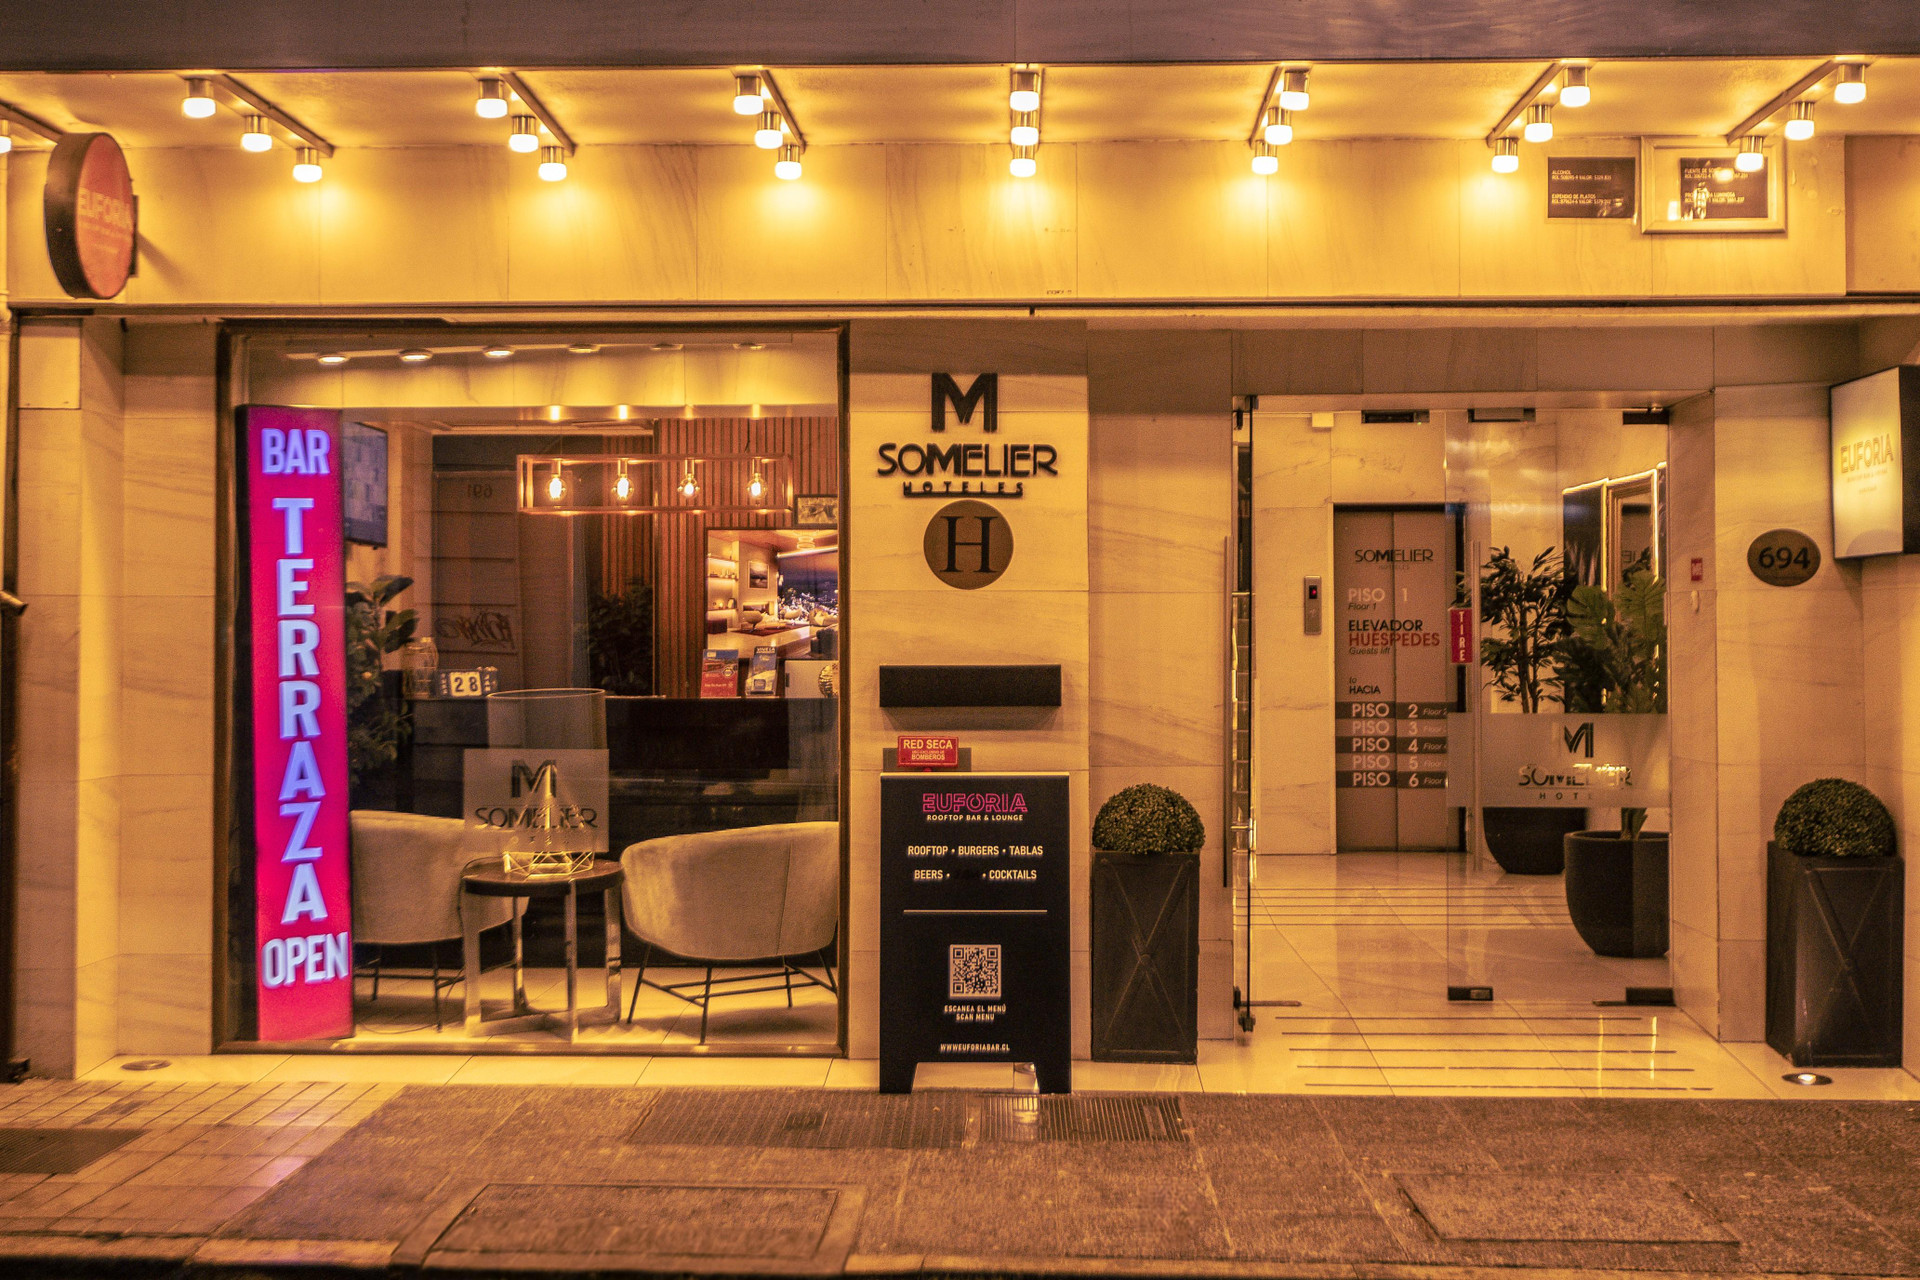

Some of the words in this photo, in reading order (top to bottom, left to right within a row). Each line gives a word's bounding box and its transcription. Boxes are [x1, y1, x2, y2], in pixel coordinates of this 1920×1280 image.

[931, 372, 998, 433] M
[262, 427, 331, 475] BAR
[1840, 433, 1894, 474] EUFORIA
[877, 442, 1058, 477] SOMELIER
[902, 481, 1024, 498] HOTELES
[940, 515, 999, 573] H
[1354, 549, 1434, 563] SOMELIER
[1757, 546, 1811, 569] 694
[1348, 588, 1386, 602] PISO
[1401, 588, 1408, 602] 1
[1348, 602, 1369, 610] Floor
[1348, 619, 1423, 631] ELEVADOR
[1349, 632, 1440, 647] HUESPEDES
[1458, 611, 1466, 661] TIRE
[1349, 647, 1378, 655] Guests
[454, 676, 478, 692] 28
[1349, 685, 1381, 694] HACIA
[272, 496, 329, 924] TERRAZA
[1352, 703, 1390, 717] PISO
[1408, 703, 1419, 718] 2
[1423, 708, 1441, 716] Floor
[1353, 720, 1390, 735] PISO
[1408, 721, 1418, 735] 3
[903, 739, 924, 749] RED
[926, 739, 953, 749] SECA
[1353, 738, 1390, 752] PISO
[1408, 738, 1419, 752] 4
[1423, 742, 1441, 750] Floor
[1353, 755, 1390, 769] PISO
[1409, 756, 1419, 770] 5
[1353, 772, 1391, 787] PISO
[1409, 773, 1419, 787] 6
[922, 793, 1028, 813] EUFORIA
[907, 845, 949, 856] ROOFTOP
[958, 845, 1000, 856] BURGERS
[1009, 845, 1044, 856] TABLAS
[914, 869, 944, 880] BEERS
[989, 869, 1037, 880] COCKTAILS
[261, 931, 349, 988] OPEN
[944, 1005, 975, 1013] ESCANEA
[976, 1005, 985, 1013] EL
[987, 1003, 1007, 1013] MENÚ
[956, 1013, 974, 1021] SCAN
[975, 1013, 995, 1021] MENU
